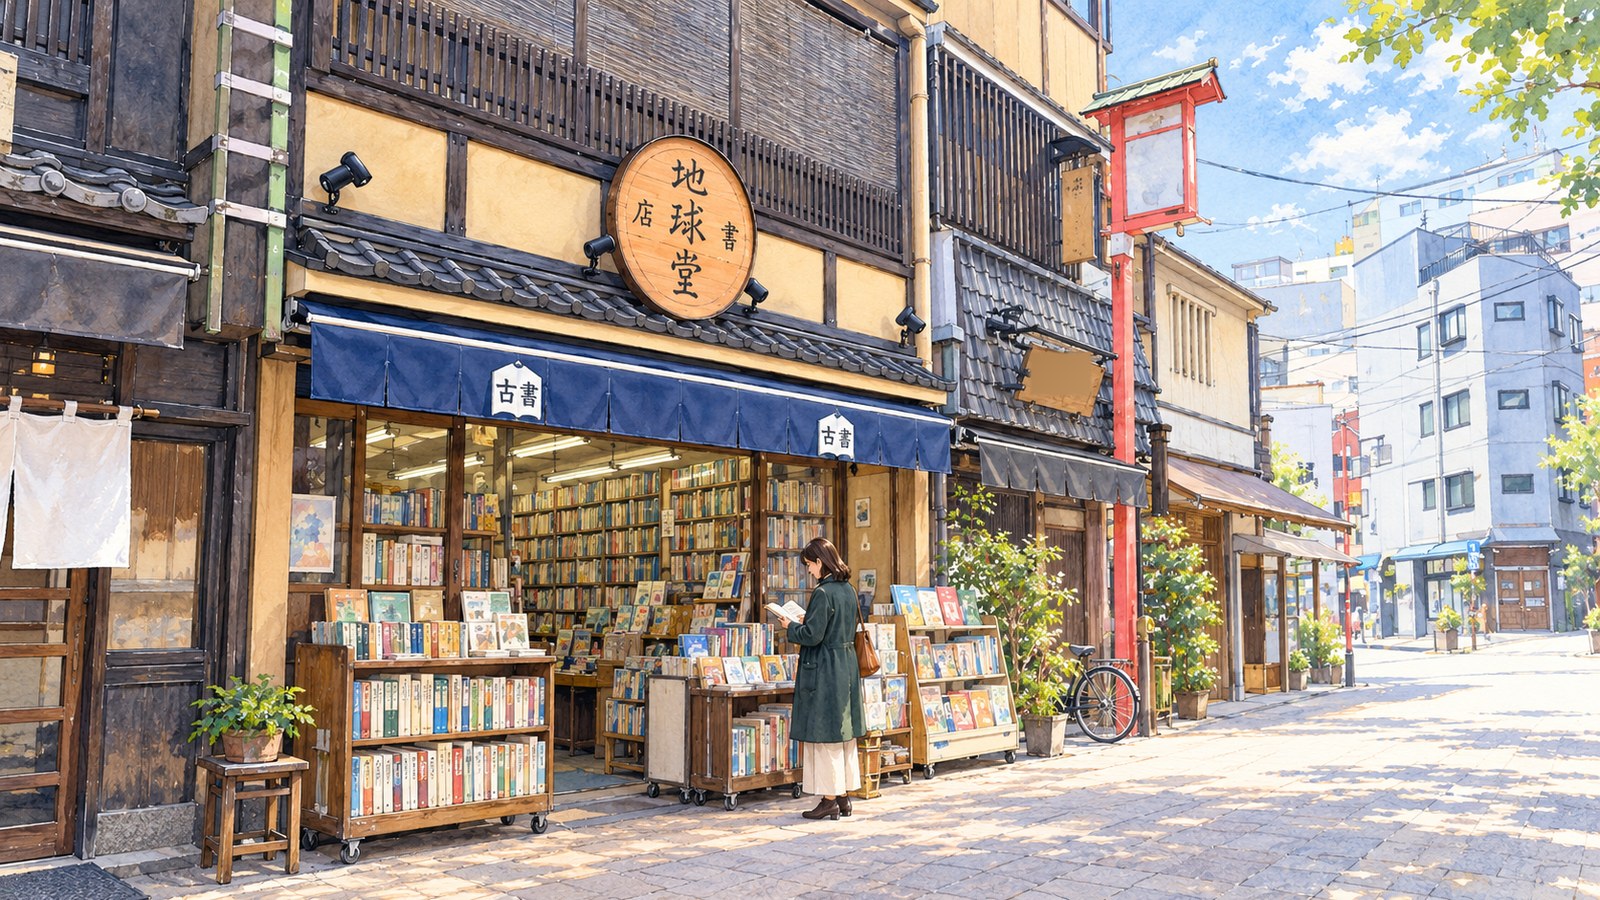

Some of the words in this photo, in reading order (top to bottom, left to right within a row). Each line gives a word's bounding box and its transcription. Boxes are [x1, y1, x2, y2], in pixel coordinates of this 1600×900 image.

[632, 199, 654, 228] 店
[669, 158, 708, 299] 地球堂
[721, 221, 739, 252] 書
[496, 378, 539, 408] 古書
[821, 426, 852, 448] 古書
